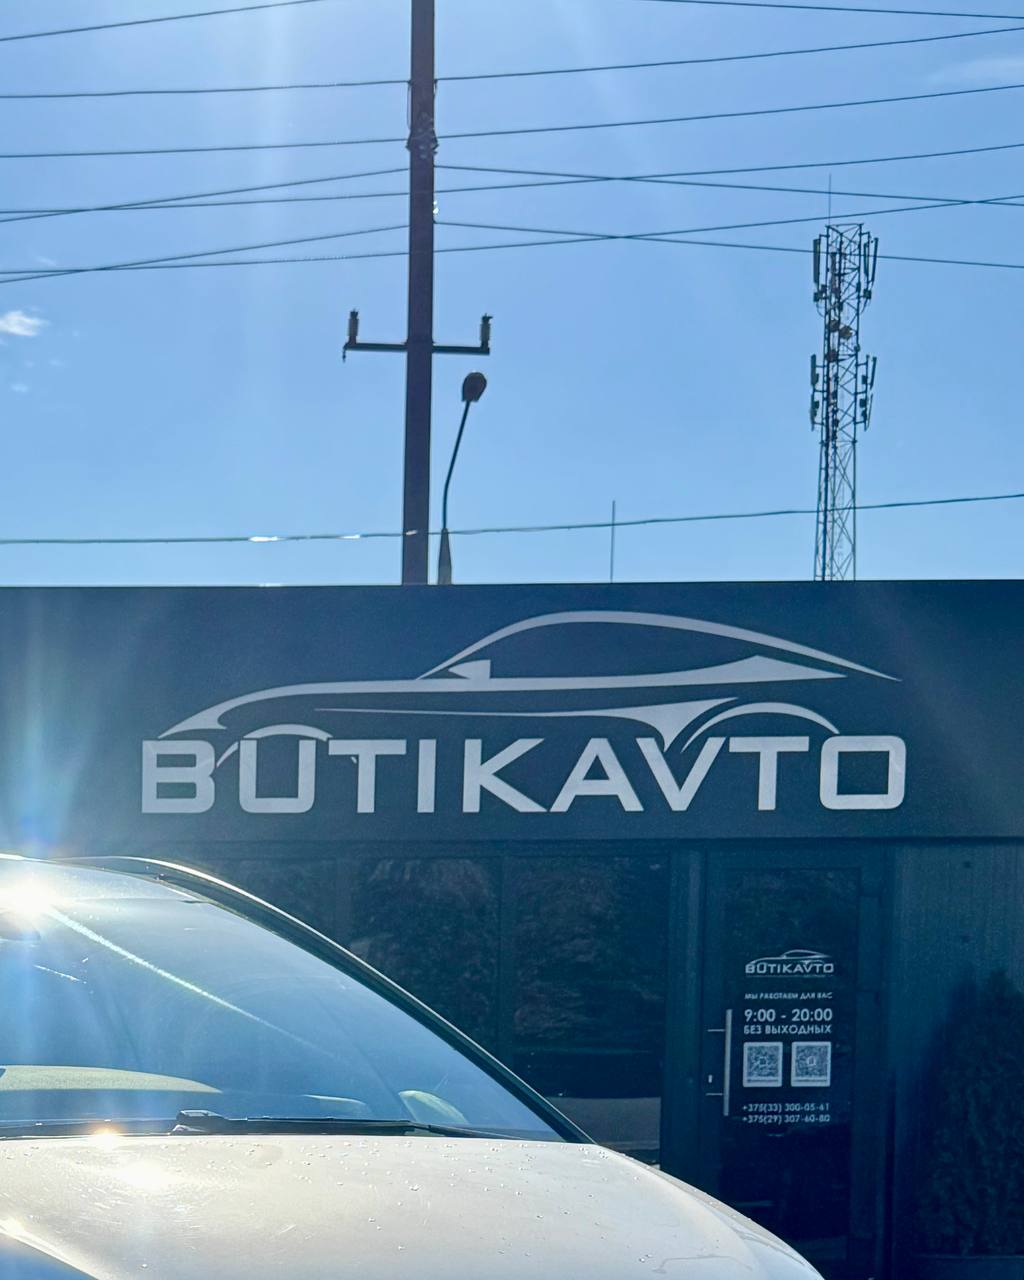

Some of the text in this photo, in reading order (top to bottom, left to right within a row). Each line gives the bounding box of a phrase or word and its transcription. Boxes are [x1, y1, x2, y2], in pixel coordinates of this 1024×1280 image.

[141, 735, 907, 815] BUTIKAVTO
[745, 963, 835, 974] BUTIKAVTO
[800, 992, 815, 1000] ДЛЯ
[744, 1008, 776, 1023] 9:00
[791, 1008, 833, 1022] 20:00
[744, 1024, 832, 1035] БЕЗ ВЫХОДНЫХ
[742, 1103, 782, 1113] +375(33)
[742, 1114, 782, 1125] +375(29)
